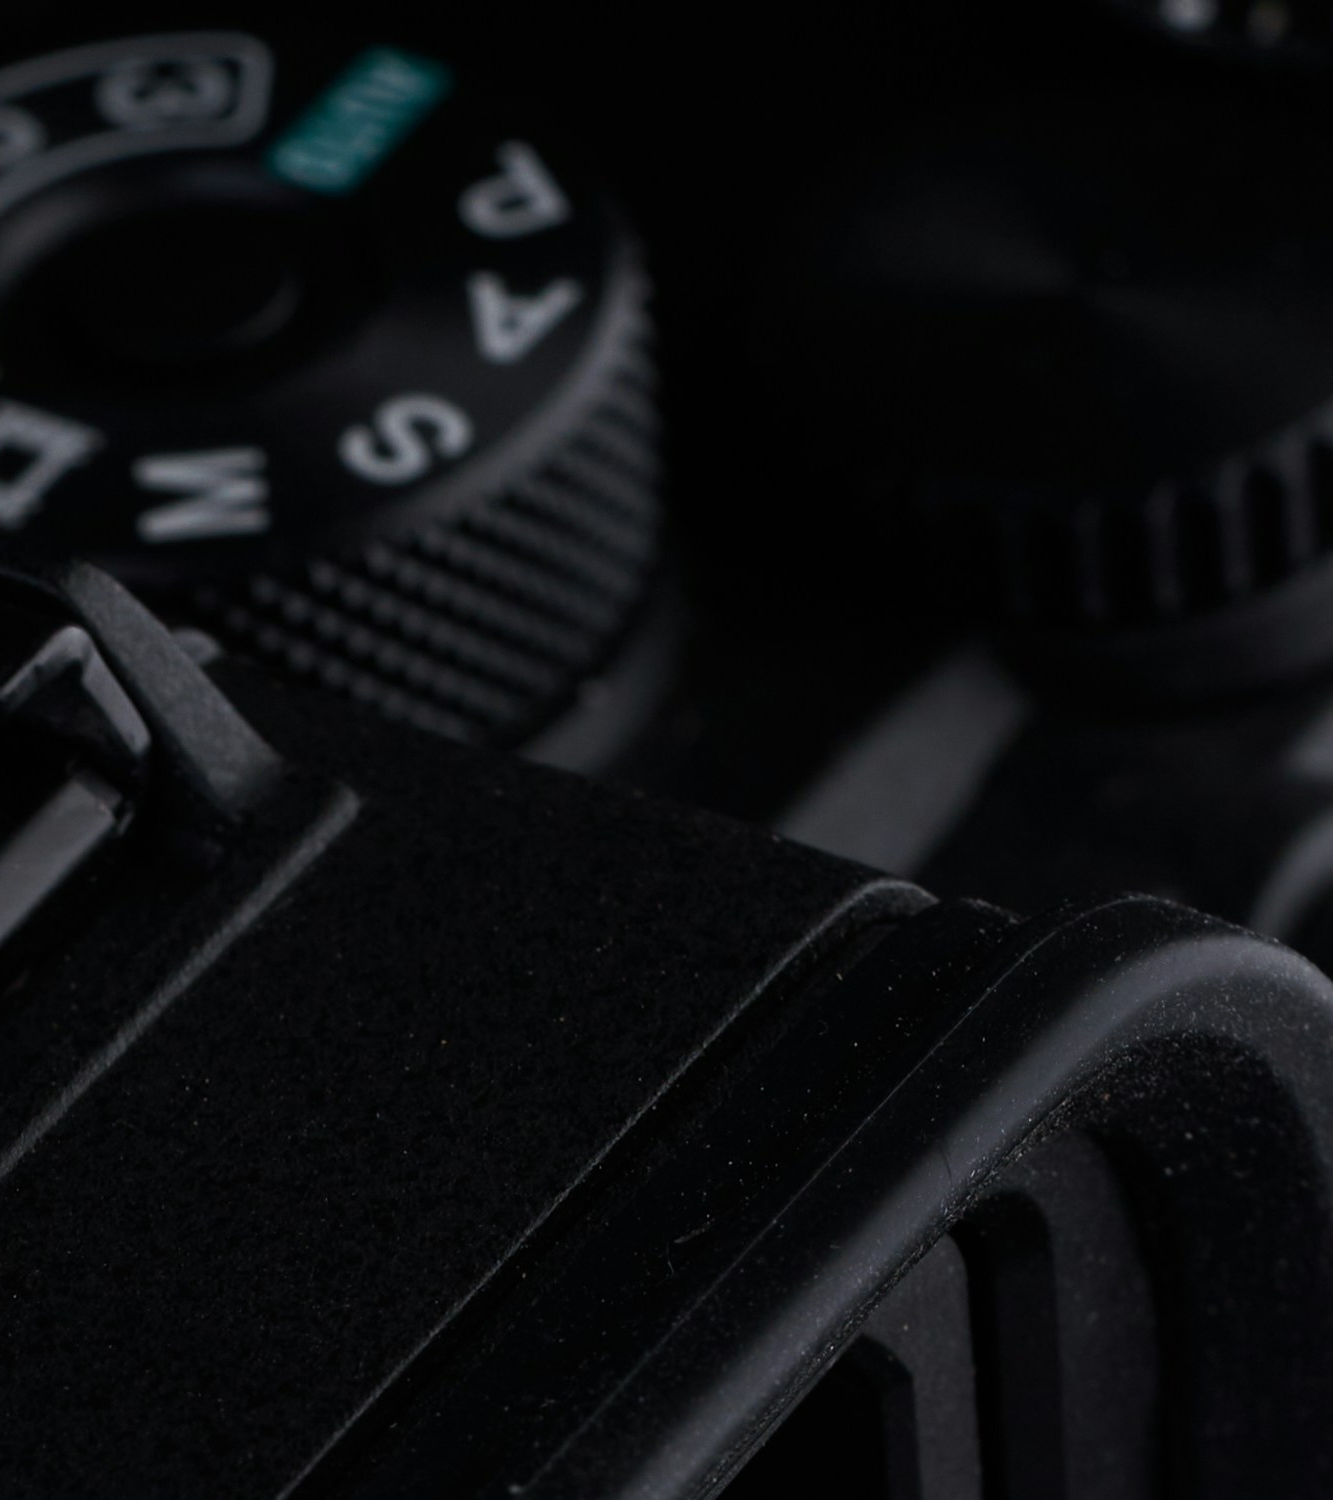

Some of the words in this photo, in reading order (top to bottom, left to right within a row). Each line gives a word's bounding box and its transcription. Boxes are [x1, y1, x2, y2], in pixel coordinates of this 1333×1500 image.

[455, 138, 575, 240] P
[466, 269, 584, 364] A
[338, 392, 474, 486] S
[132, 445, 272, 544] M
